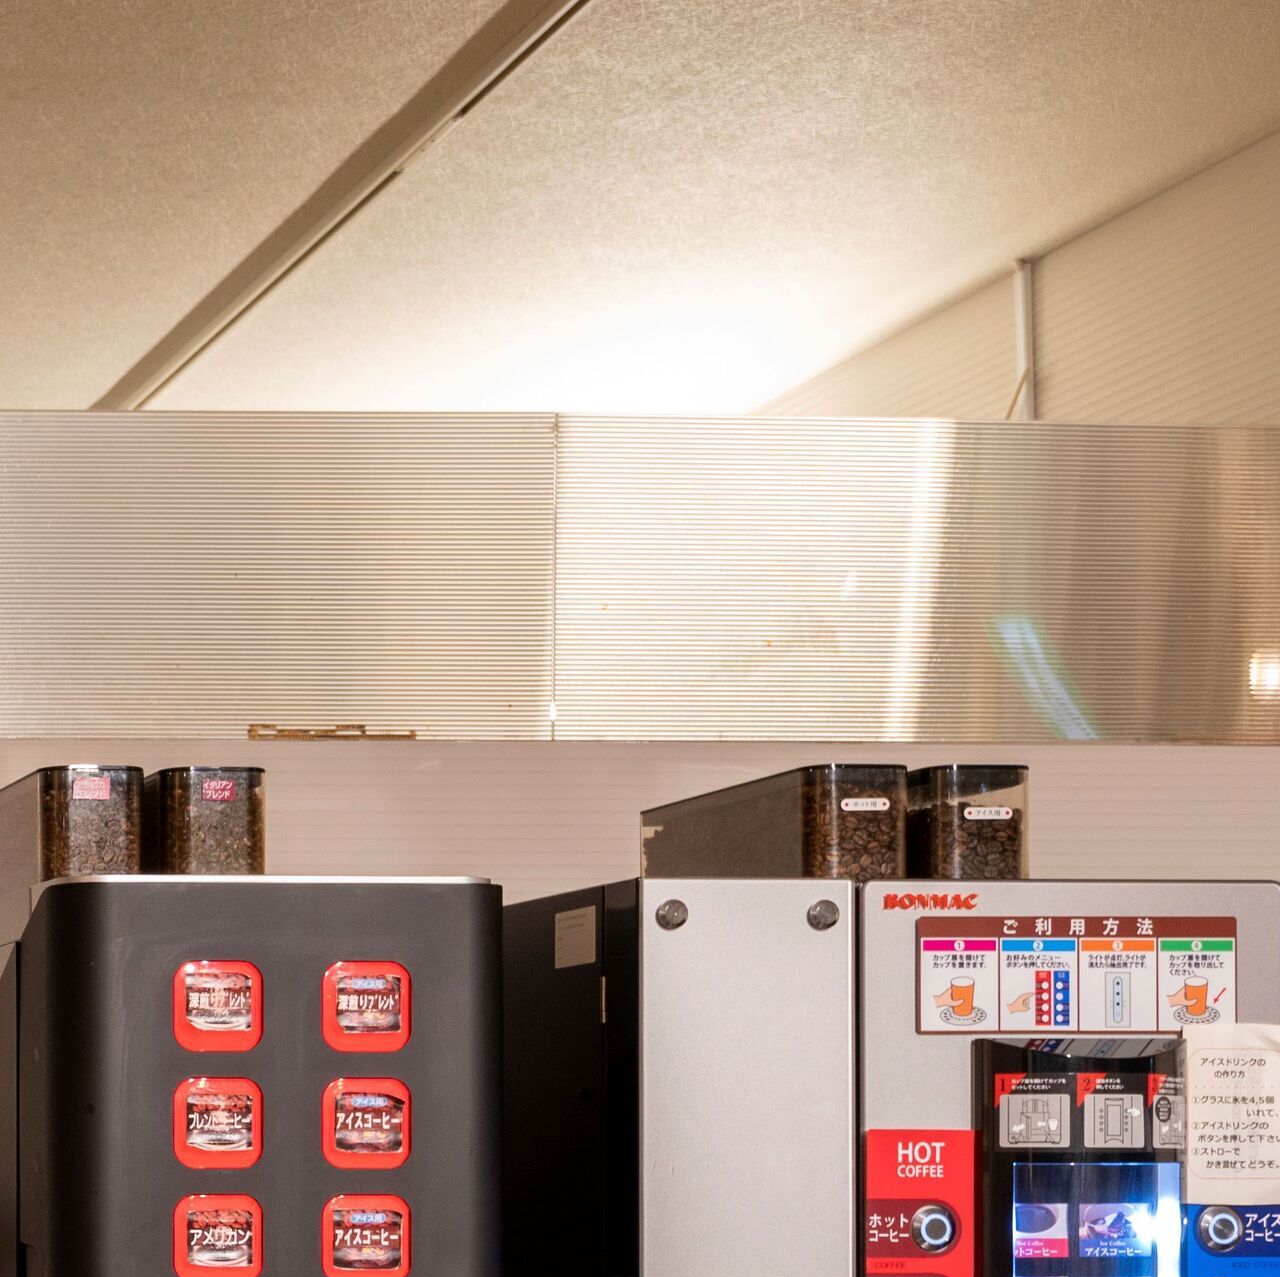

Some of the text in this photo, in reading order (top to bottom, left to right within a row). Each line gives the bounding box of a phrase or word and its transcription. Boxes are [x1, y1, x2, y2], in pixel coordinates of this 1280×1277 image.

[203, 780, 233, 789] イタリアン
[206, 790, 231, 800] ブレンド
[882, 893, 979, 910] BONMAC
[1002, 918, 1154, 936] ご利用方法
[1200, 1057, 1266, 1067] アイスドリンクの
[1214, 1070, 1245, 1079] の作り方
[336, 1112, 401, 1131] アイスコーヒー
[897, 1142, 945, 1163] HOT
[897, 1165, 945, 1178] COFFEE
[868, 1213, 909, 1228] ホット
[190, 1228, 252, 1246] アメリカン
[335, 1228, 399, 1247] アイスコーヒー
[869, 1229, 910, 1242] コーヒー
[1085, 1248, 1143, 1257] アイスコーヒー
